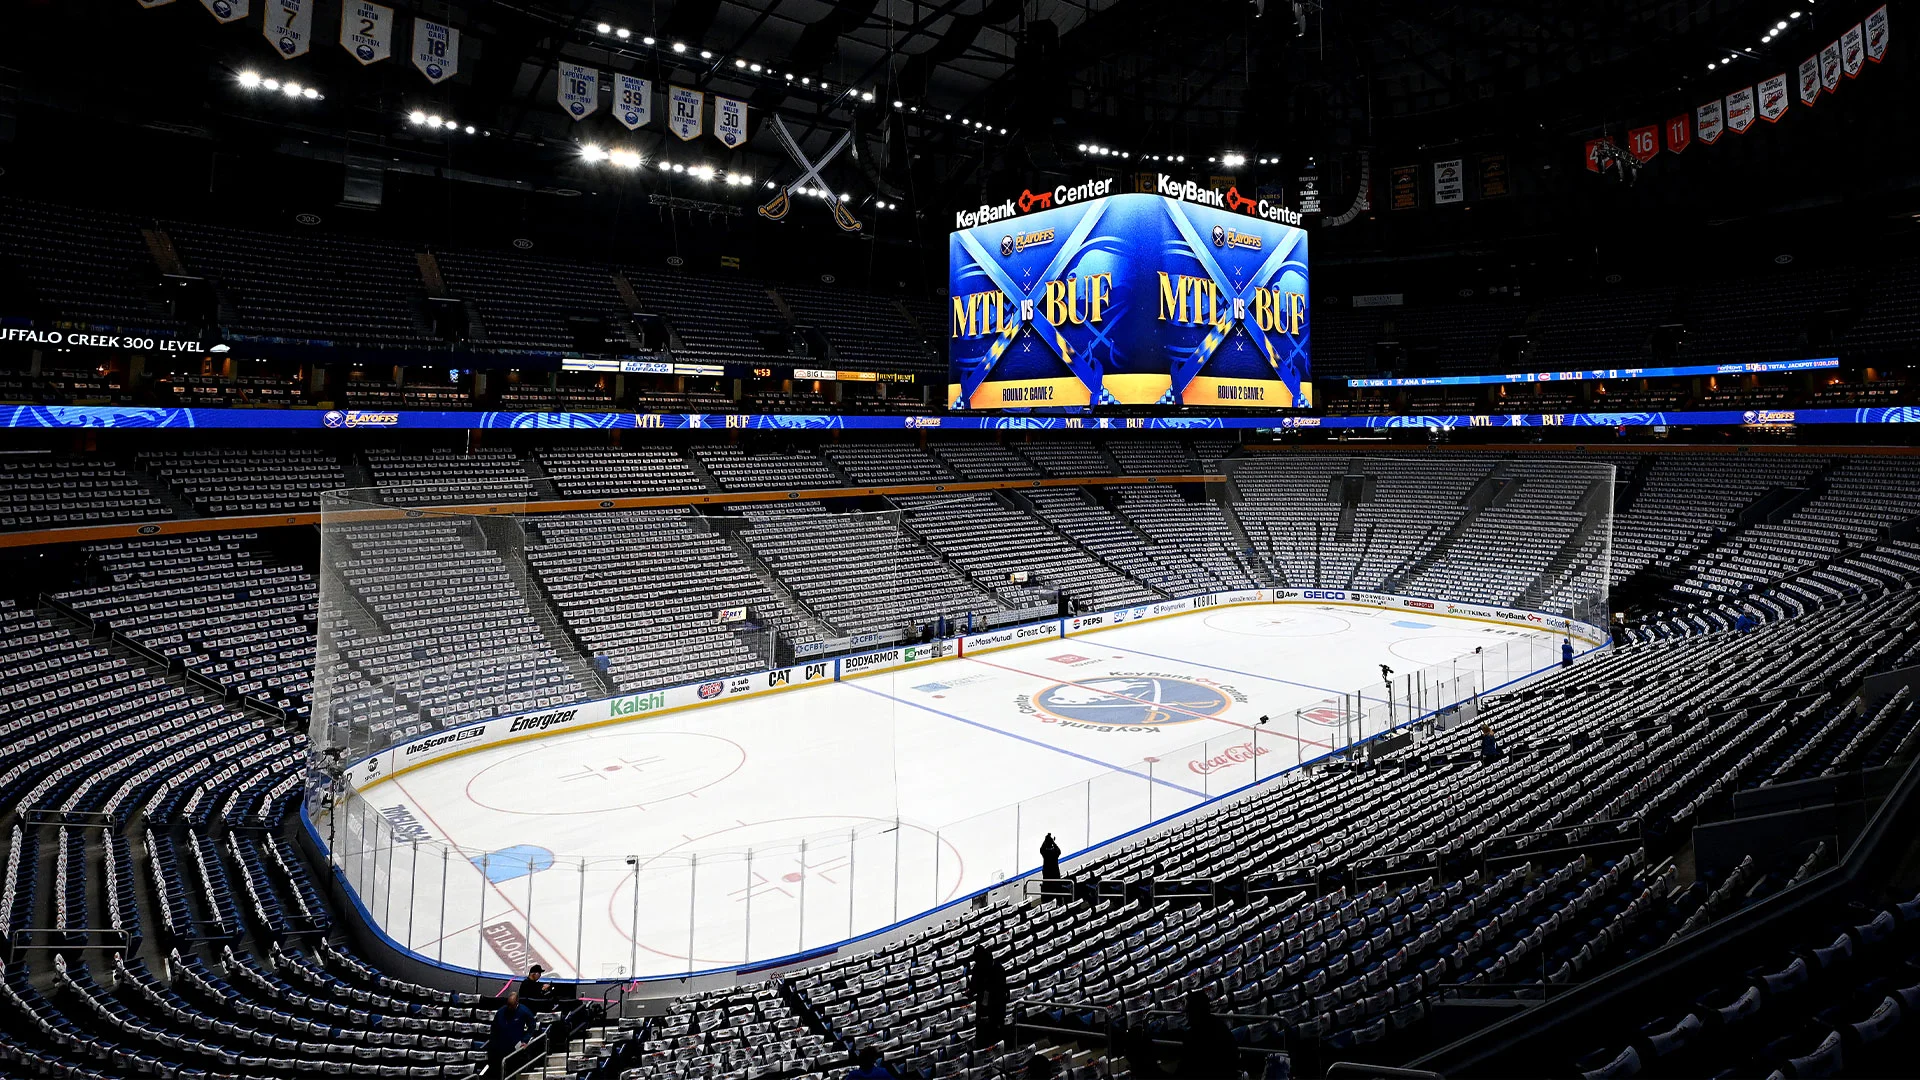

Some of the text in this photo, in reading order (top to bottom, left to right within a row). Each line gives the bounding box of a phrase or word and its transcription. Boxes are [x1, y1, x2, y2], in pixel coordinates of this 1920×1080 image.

[284, 8, 297, 28] 7
[360, 19, 375, 38] 2
[428, 31, 445, 41] GARE
[428, 38, 445, 57] 18
[570, 79, 587, 96] 16
[623, 90, 642, 106] 39
[678, 102, 694, 118] RJ
[723, 112, 738, 128] 30
[1672, 121, 1683, 143] 11
[1634, 132, 1652, 153] 16
[957, 178, 1112, 228] KeyBank Center
[1157, 173, 1302, 226] KeyBank Center
[1016, 229, 1055, 246] PLAYOFFS
[1228, 231, 1262, 248] PLAYOFFS
[952, 271, 1112, 338] MTL VS BUF
[1157, 271, 1306, 336] MTL VS BUF
[67, 333, 120, 347] CREEK
[123, 336, 154, 350] 300
[160, 340, 205, 352] LEVEL
[754, 368, 770, 377] 4:53
[807, 370, 819, 378] BIG
[1746, 363, 1767, 372] 50/50
[1002, 386, 1054, 401] ROUND 2 GAME 2
[1217, 386, 1264, 401] ROUND 2 GAME 2
[345, 413, 398, 424] PLAYOFFS
[635, 414, 750, 428] MTL VS BUF
[915, 418, 941, 426] PLAYOFFS
[1294, 418, 1320, 426] PLAYOFFS
[1469, 414, 1564, 426] MTL VS BUF
[1758, 411, 1795, 420] PLAYOFFS
[1065, 418, 1144, 428] MTL VS BUF
[1193, 594, 1217, 608] NOBULL
[1304, 591, 1345, 600] GEICO
[1361, 594, 1394, 602] NORWEGIAN
[1134, 608, 1145, 618] SAP
[1161, 602, 1186, 612] Polymarket
[1448, 607, 1491, 617] DRAFTKINGS
[1083, 617, 1103, 626] PEPSI
[1114, 612, 1126, 622] SAP
[1496, 610, 1526, 621] KeyBank
[860, 634, 877, 643] CFBT
[976, 633, 1012, 644] MassMutual
[1017, 625, 1057, 638] Great Clips
[804, 643, 823, 652] CFBT
[846, 650, 899, 668] BODYARMOR
[769, 669, 791, 687] CAT
[806, 663, 827, 681] CAT
[737, 678, 749, 686] sub
[1109, 671, 1249, 704] KeyBank Center
[730, 685, 750, 694] above
[610, 692, 665, 717] Kalshi
[1014, 694, 1161, 733] KeyBank Center
[510, 709, 578, 733] Energizer
[406, 734, 457, 755] theScore
[458, 727, 485, 740] BET
[364, 771, 381, 783] SPORTS
